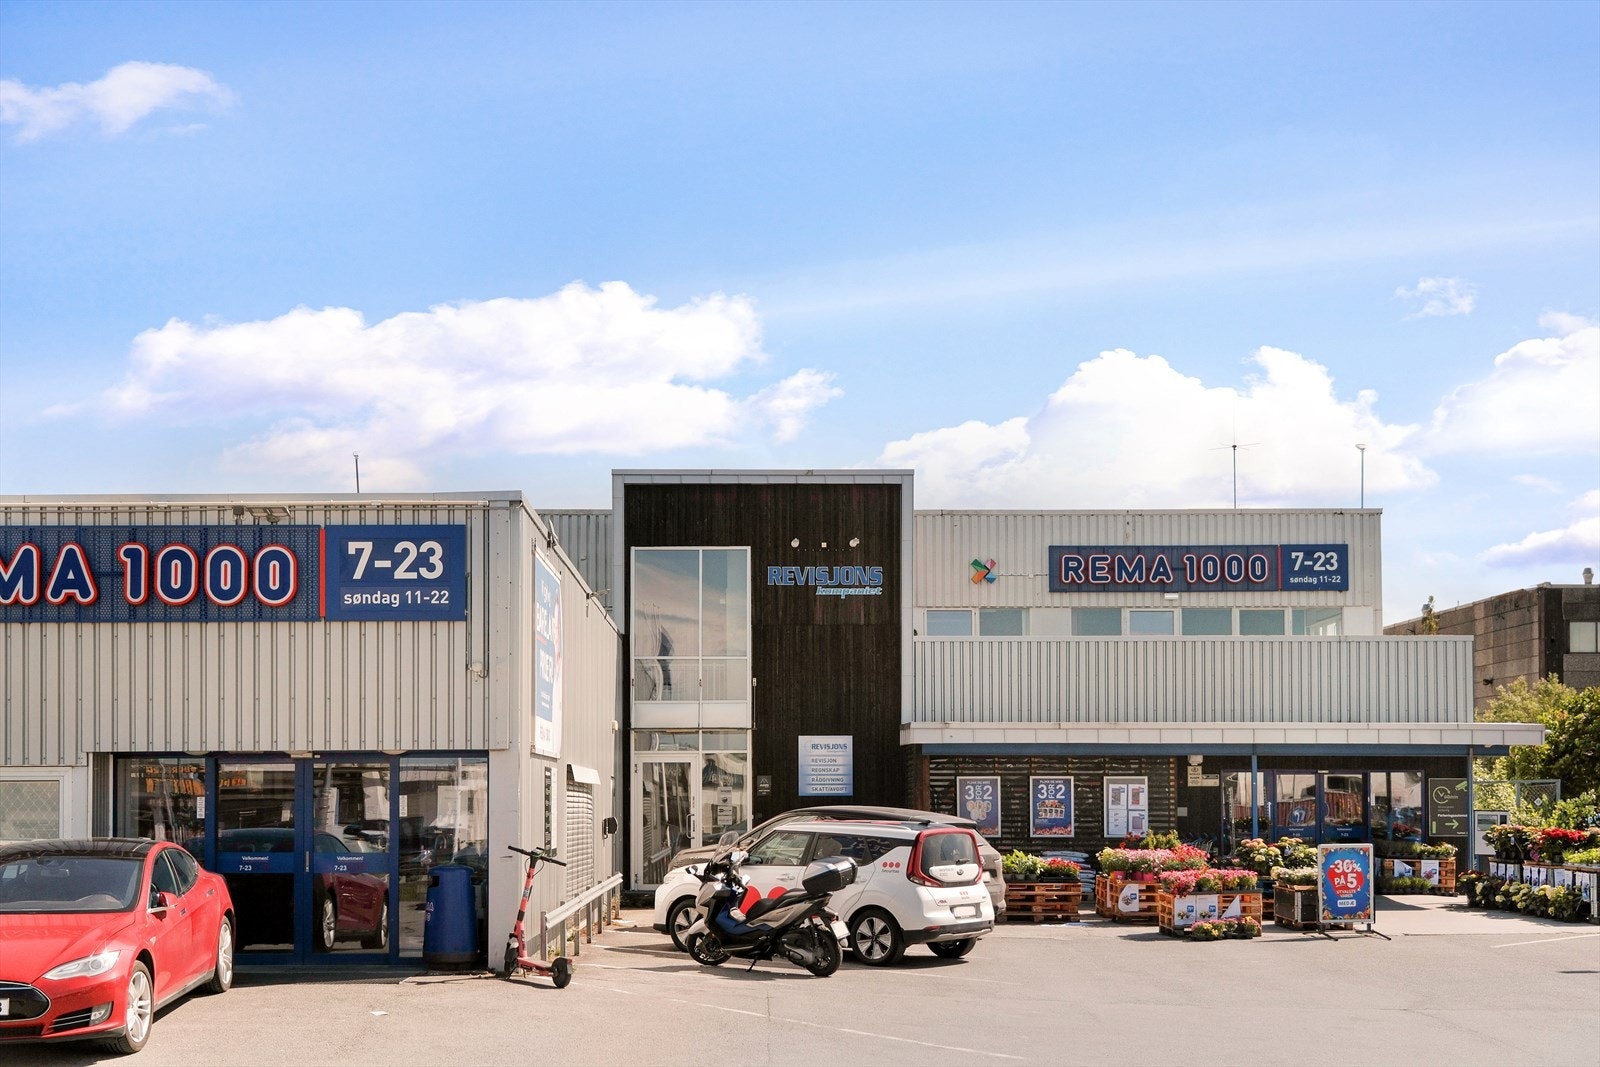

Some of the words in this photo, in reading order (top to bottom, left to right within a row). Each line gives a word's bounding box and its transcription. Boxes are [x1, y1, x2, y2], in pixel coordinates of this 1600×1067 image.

[347, 541, 444, 580] 7-23
[1060, 553, 1174, 584] REMA
[1183, 553, 1269, 584] 1000
[1291, 552, 1338, 571] 7-23
[118, 542, 297, 607] 1000
[767, 566, 883, 586] REVISJONS
[1290, 576, 1317, 585] søndag
[343, 590, 400, 608] søndag
[405, 590, 449, 604] 11-22
[965, 785, 974, 800] 3
[983, 785, 993, 800] 2
[1038, 784, 1047, 799] 3
[1056, 784, 1065, 799] 2
[1330, 859, 1361, 873] -30%
[1334, 875, 1346, 885] PÅ
[1347, 873, 1357, 888] 5
